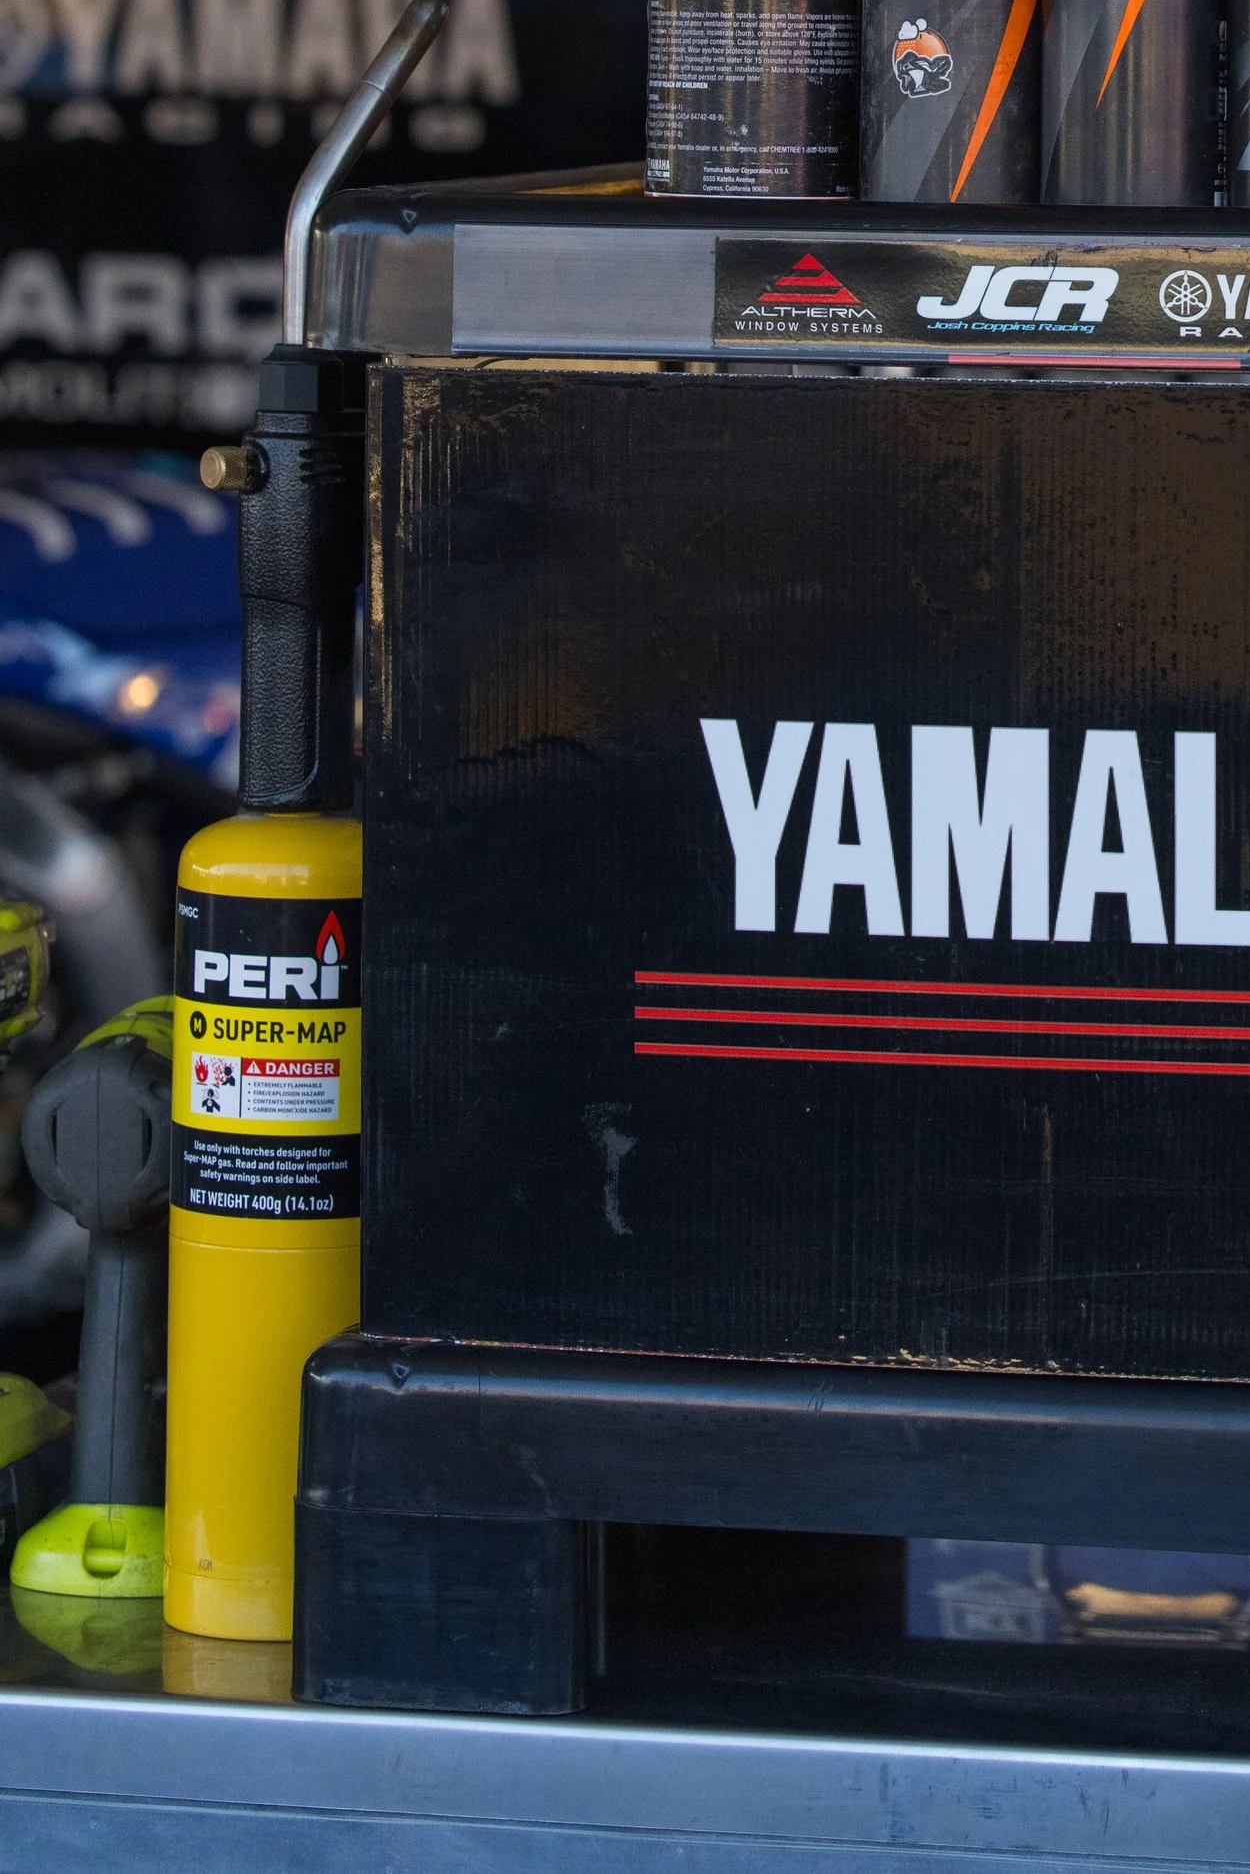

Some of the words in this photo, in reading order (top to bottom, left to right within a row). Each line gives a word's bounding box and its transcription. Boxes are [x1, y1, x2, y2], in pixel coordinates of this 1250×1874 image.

[917, 265, 1119, 322] JCR
[741, 306, 876, 319] ALTHERM
[735, 321, 799, 331] WINDOW
[811, 323, 883, 333] SYSTEMS
[971, 322, 1035, 332] Coppins
[1039, 323, 1094, 334] Racing
[213, 1018, 347, 1043] SUPER-MAP
[266, 1062, 334, 1074] DANGER
[194, 1140, 206, 1151] Use
[207, 1143, 222, 1155] only
[223, 1145, 240, 1155] with
[242, 1146, 274, 1157] torches
[277, 1148, 317, 1159] designed
[319, 1148, 331, 1156] for
[184, 1152, 216, 1165] Super-MAP
[218, 1158, 234, 1168] gas.
[236, 1159, 256, 1169] Read
[258, 1160, 274, 1170] and
[277, 1160, 304, 1170] follow
[306, 1160, 348, 1172] important
[200, 1169, 222, 1182] safety
[223, 1172, 260, 1185] warnings
[263, 1175, 273, 1183] on
[275, 1175, 293, 1183] side
[296, 1175, 320, 1184] label.
[190, 1188, 206, 1203] NET
[208, 1192, 249, 1209] WEIGHT
[252, 1196, 281, 1214] 400g
[285, 1194, 334, 1212] (14.1oz)
